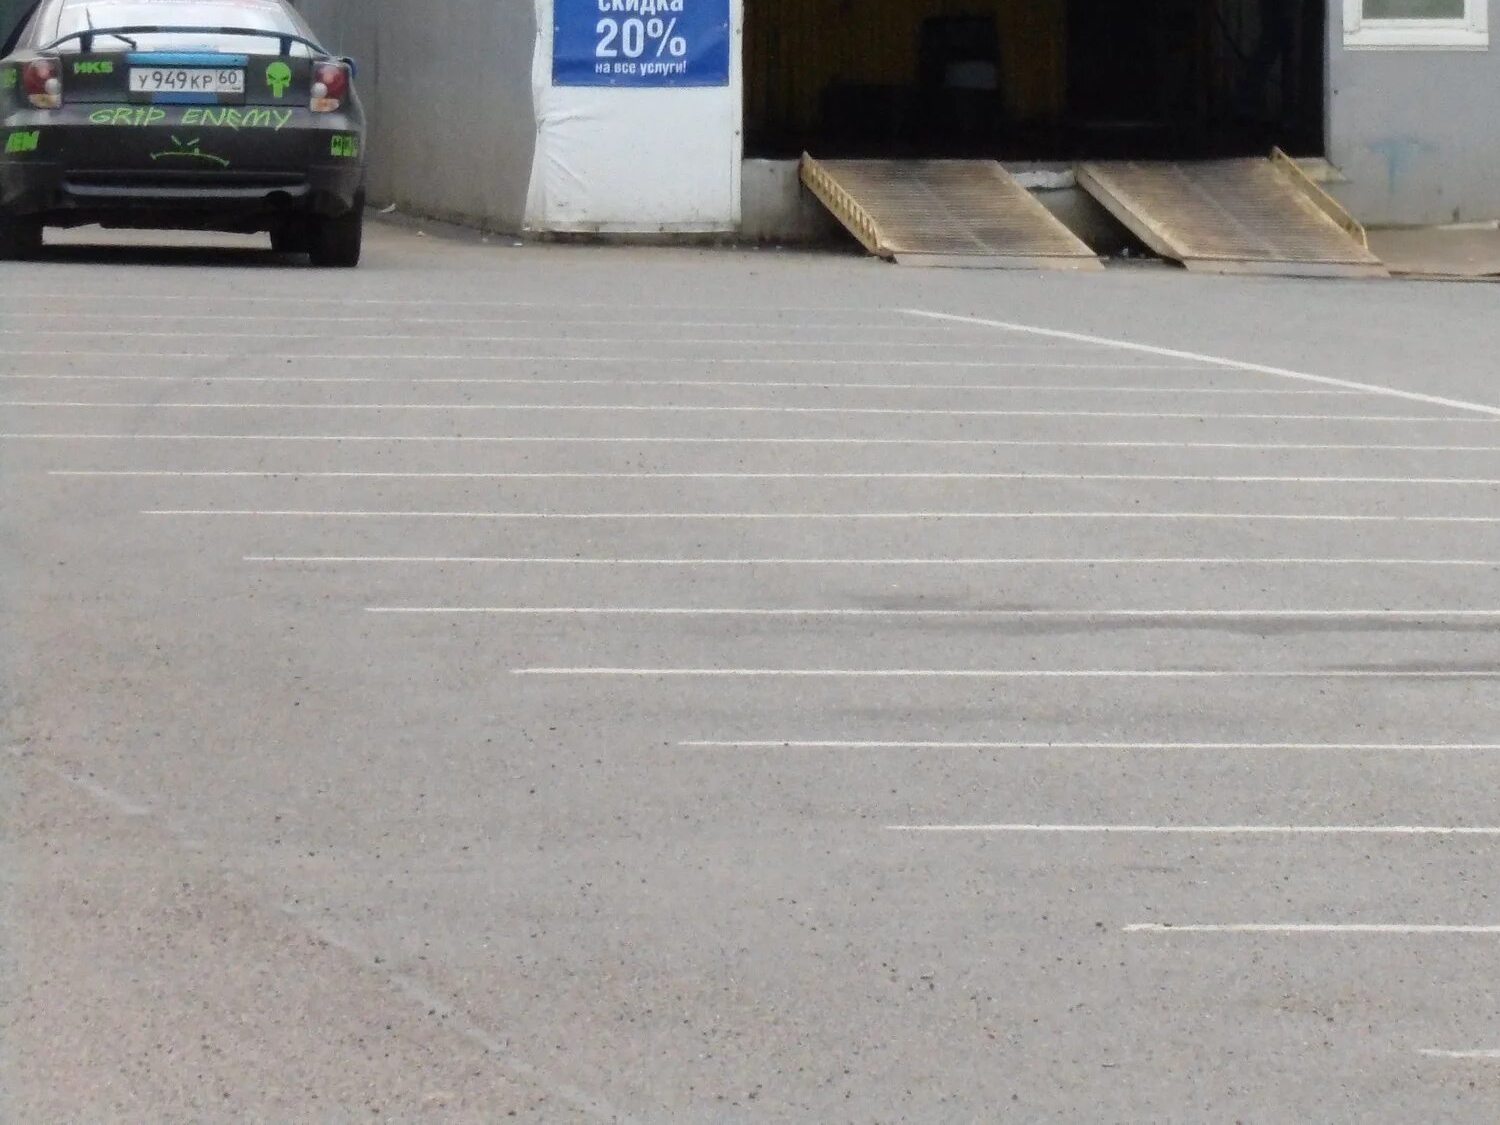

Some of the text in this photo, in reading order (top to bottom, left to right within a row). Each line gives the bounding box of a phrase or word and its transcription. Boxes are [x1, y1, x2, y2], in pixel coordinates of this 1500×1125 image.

[595, 18, 687, 57] 20%
[595, 61, 687, 77] на все услуги!
[181, 108, 293, 131] ENEMY
